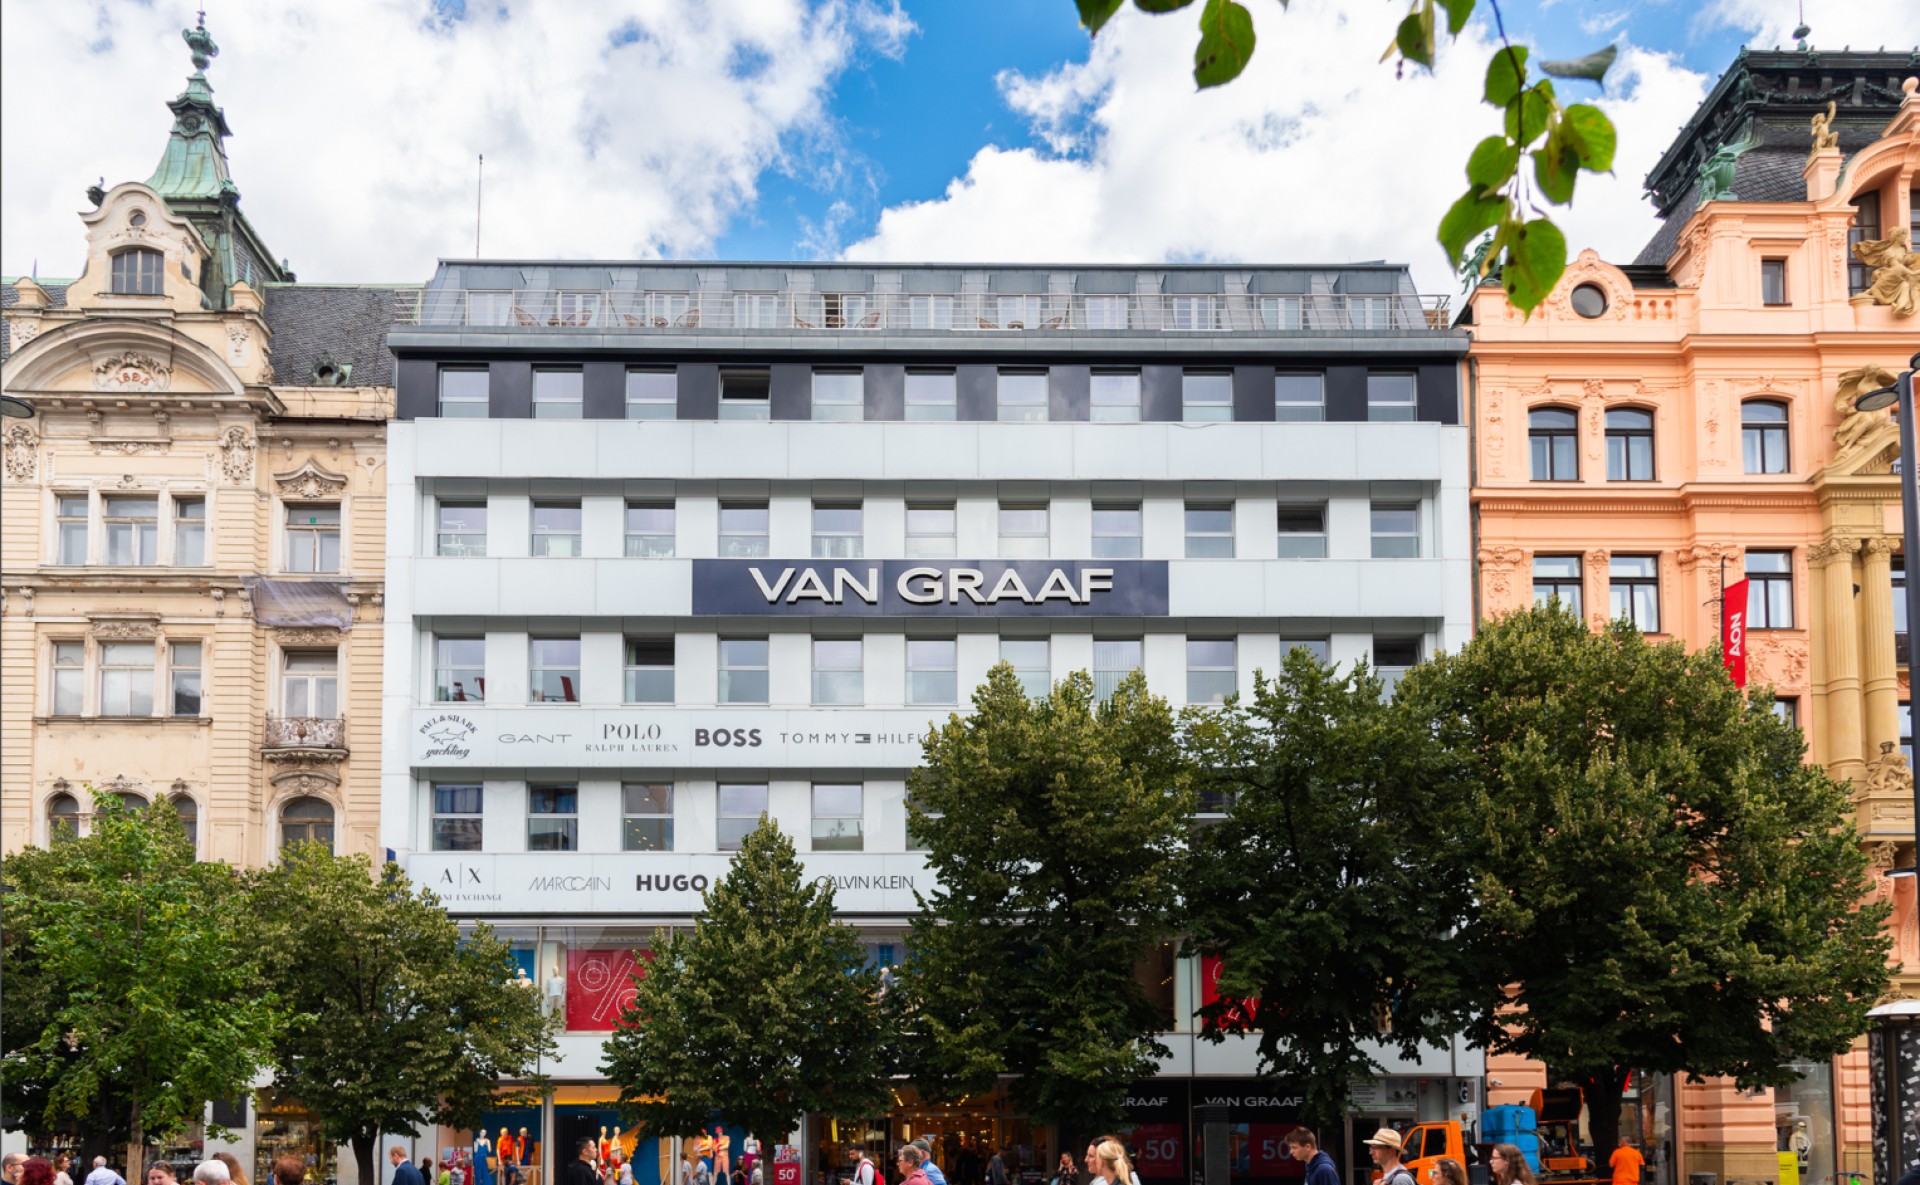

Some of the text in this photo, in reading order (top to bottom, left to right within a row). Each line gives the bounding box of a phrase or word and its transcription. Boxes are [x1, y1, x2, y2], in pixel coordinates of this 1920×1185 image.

[748, 567, 1114, 604] VAN GRAAF
[1728, 611, 1742, 656] AON
[419, 714, 478, 735] PAUL & SHARK
[603, 723, 661, 740] POLO
[498, 733, 572, 744] GANT
[695, 728, 763, 748] BOSS
[780, 733, 850, 744] TOMMY
[420, 743, 471, 760] yachting
[585, 744, 679, 752] RALPH LAUREN
[636, 874, 709, 892] HUGO
[814, 876, 914, 890] CALVIN KLEIN
[456, 893, 502, 901] EXCHANGE
[1204, 1096, 1304, 1107] VAN GRAAF
